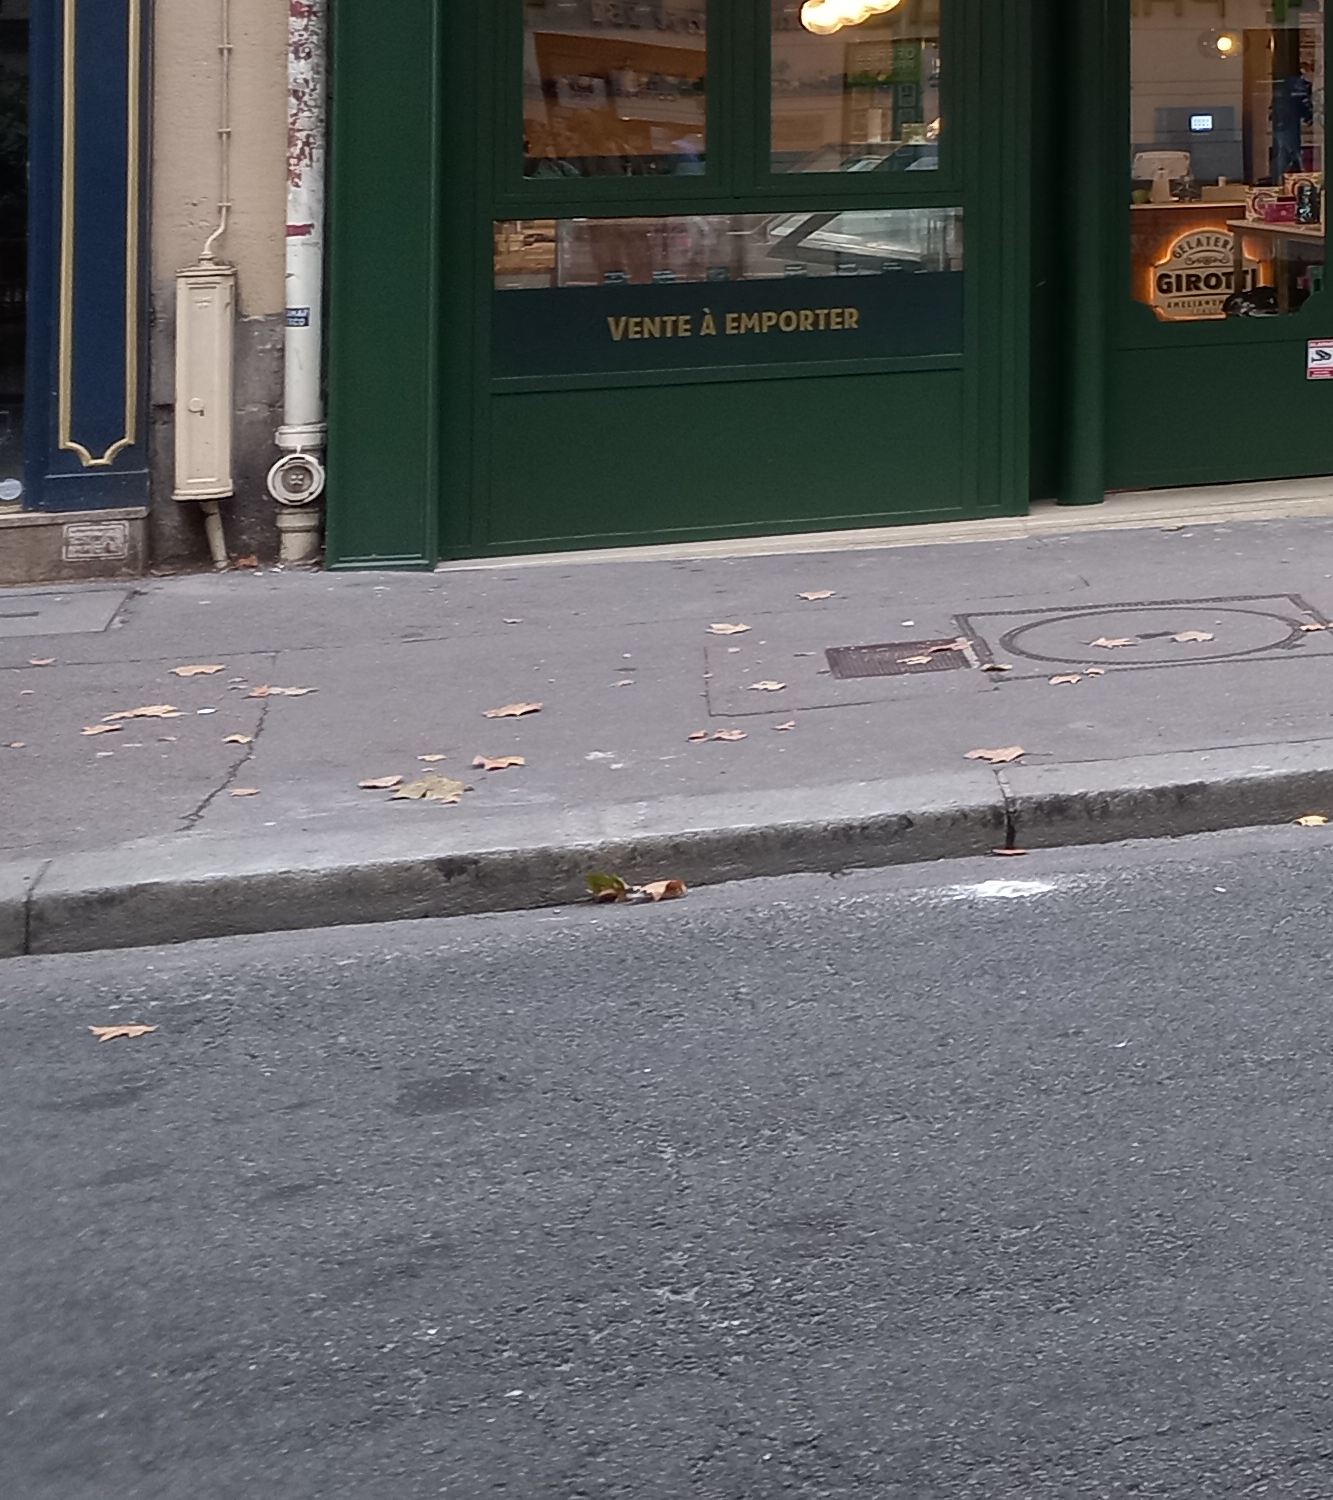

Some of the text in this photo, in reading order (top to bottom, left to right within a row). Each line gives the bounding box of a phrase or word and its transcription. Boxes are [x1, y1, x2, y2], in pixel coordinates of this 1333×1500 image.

[1172, 236, 1234, 259] GELATERI
[607, 307, 859, 341] VENTE À EMPORTER
